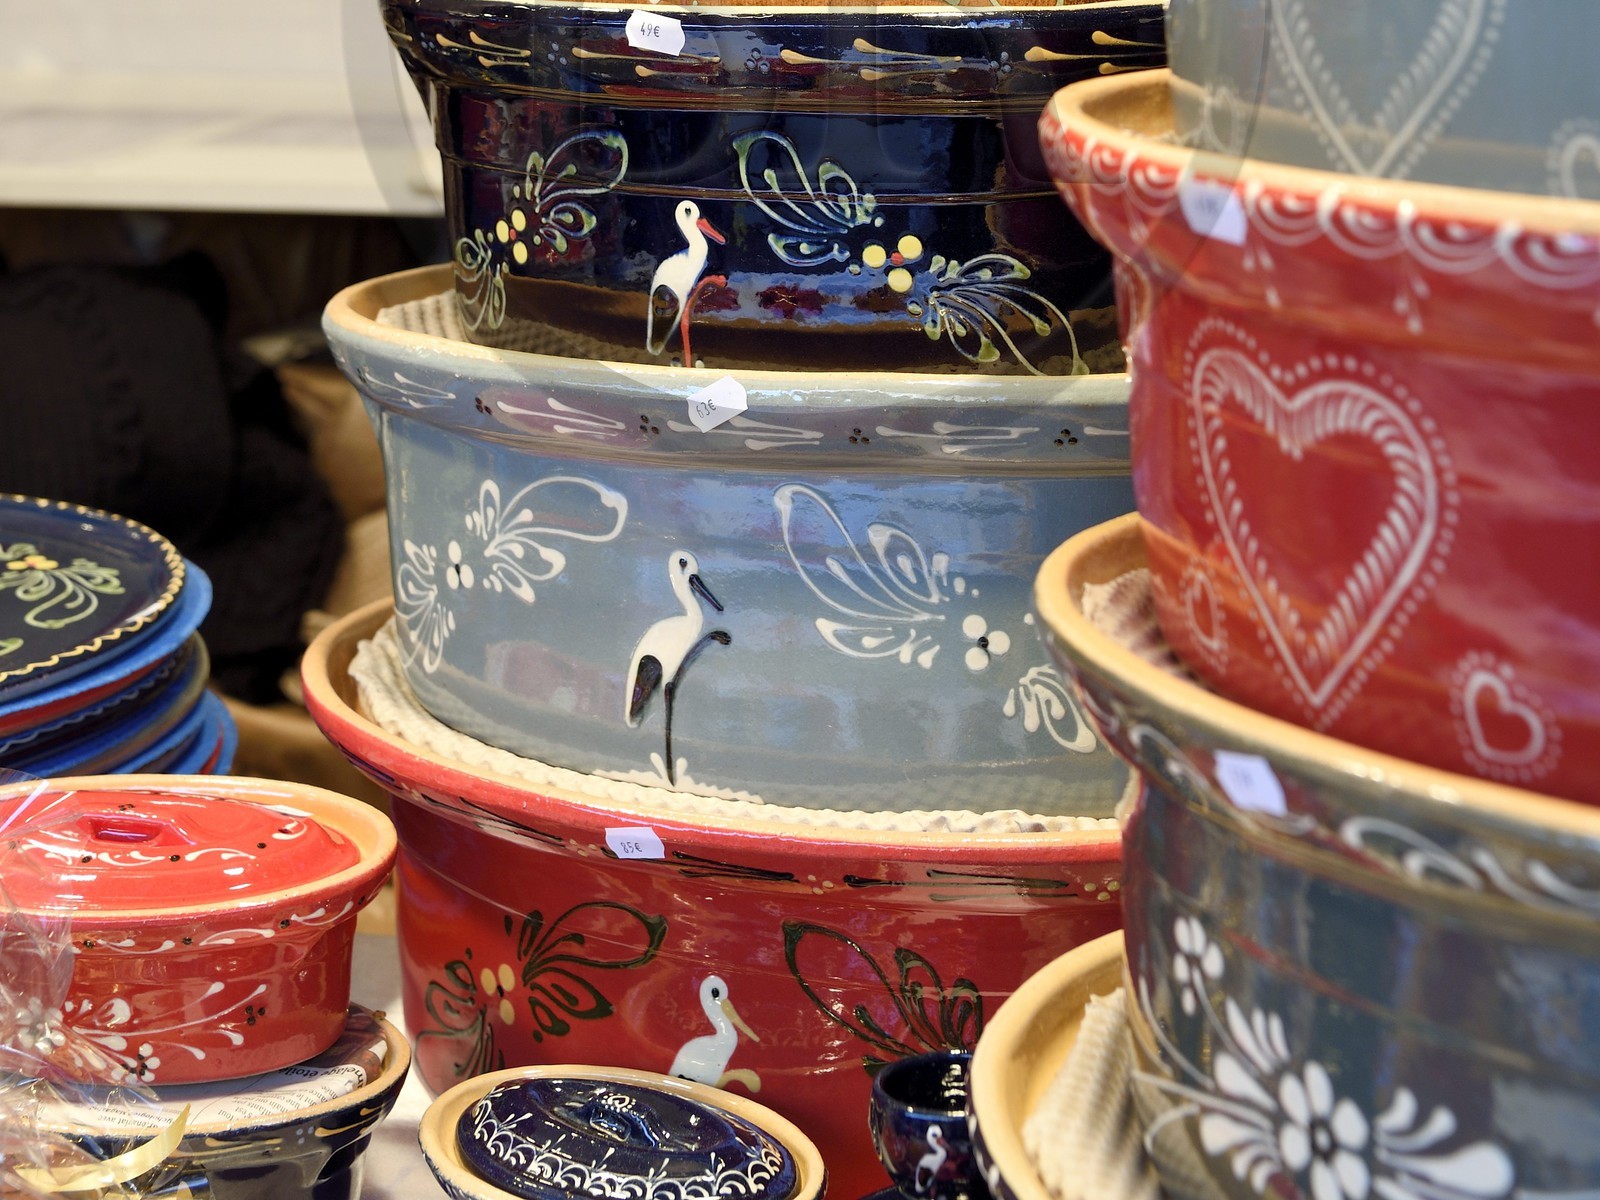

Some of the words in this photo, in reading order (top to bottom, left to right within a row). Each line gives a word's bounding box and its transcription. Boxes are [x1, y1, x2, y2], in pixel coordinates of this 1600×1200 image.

[639, 21, 661, 38] 49€
[696, 398, 717, 419] 63€
[620, 841, 643, 855] 85€
